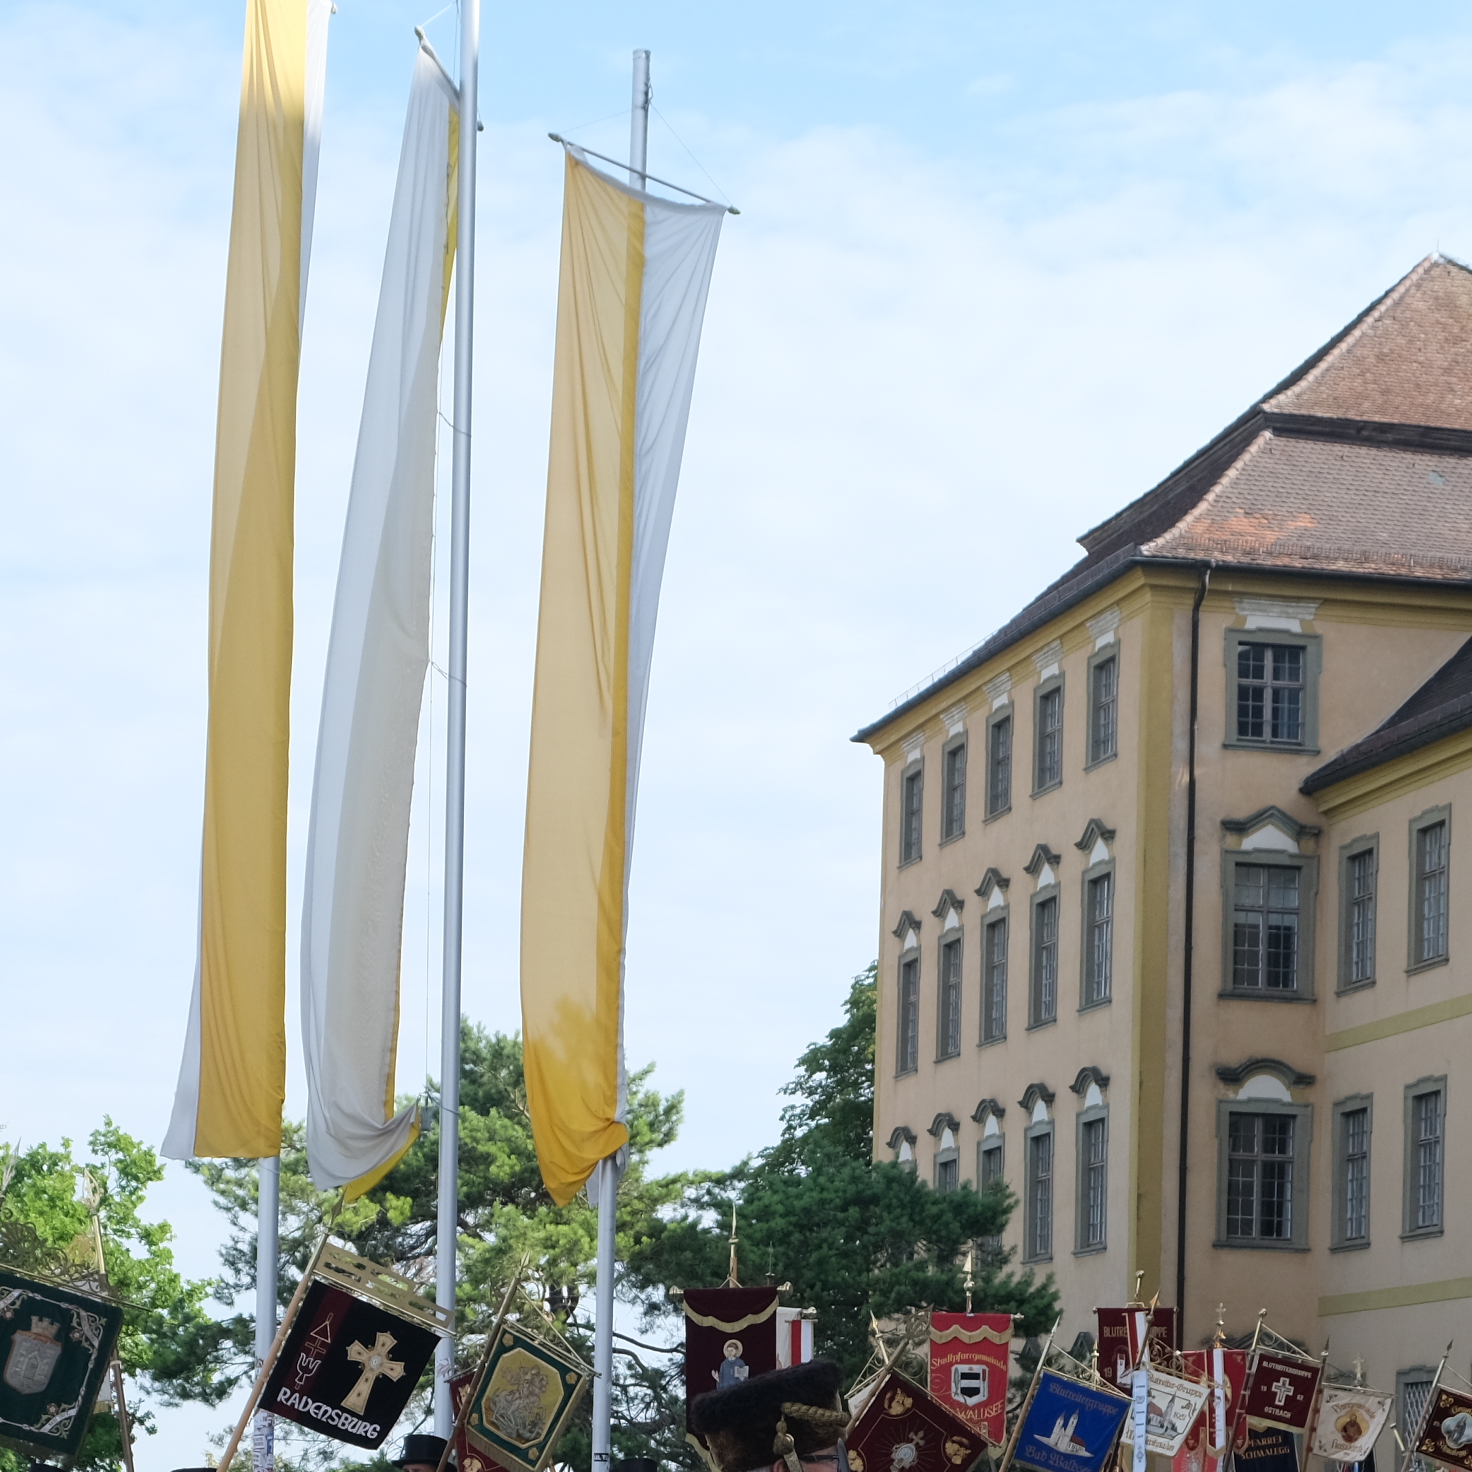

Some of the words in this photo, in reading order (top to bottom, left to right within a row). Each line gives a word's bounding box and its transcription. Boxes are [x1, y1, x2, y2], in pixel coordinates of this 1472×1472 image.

[1260, 1357, 1314, 1379] BLUTREITERGRUPPE
[1047, 1382, 1120, 1415] Blutreitergruppe
[1263, 1405, 1292, 1420] OSTRACH
[1024, 1442, 1054, 1463] Bad
